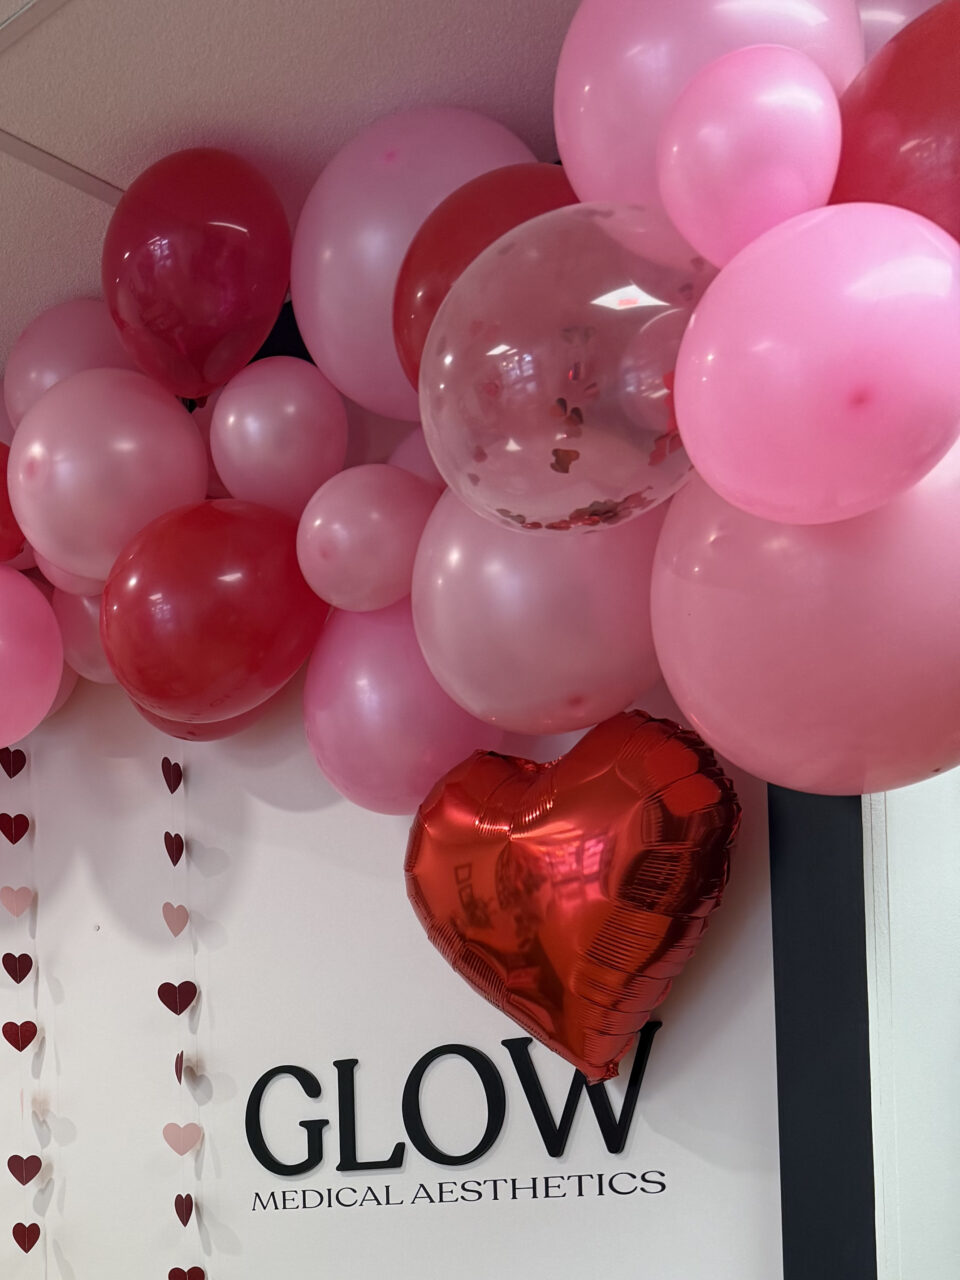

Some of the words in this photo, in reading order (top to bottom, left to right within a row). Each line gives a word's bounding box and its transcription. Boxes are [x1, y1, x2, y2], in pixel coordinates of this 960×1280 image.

[245, 1019, 662, 1176] GLOW
[251, 1185, 404, 1211] MEDICAL
[411, 1170, 667, 1204] AESTHETICS
